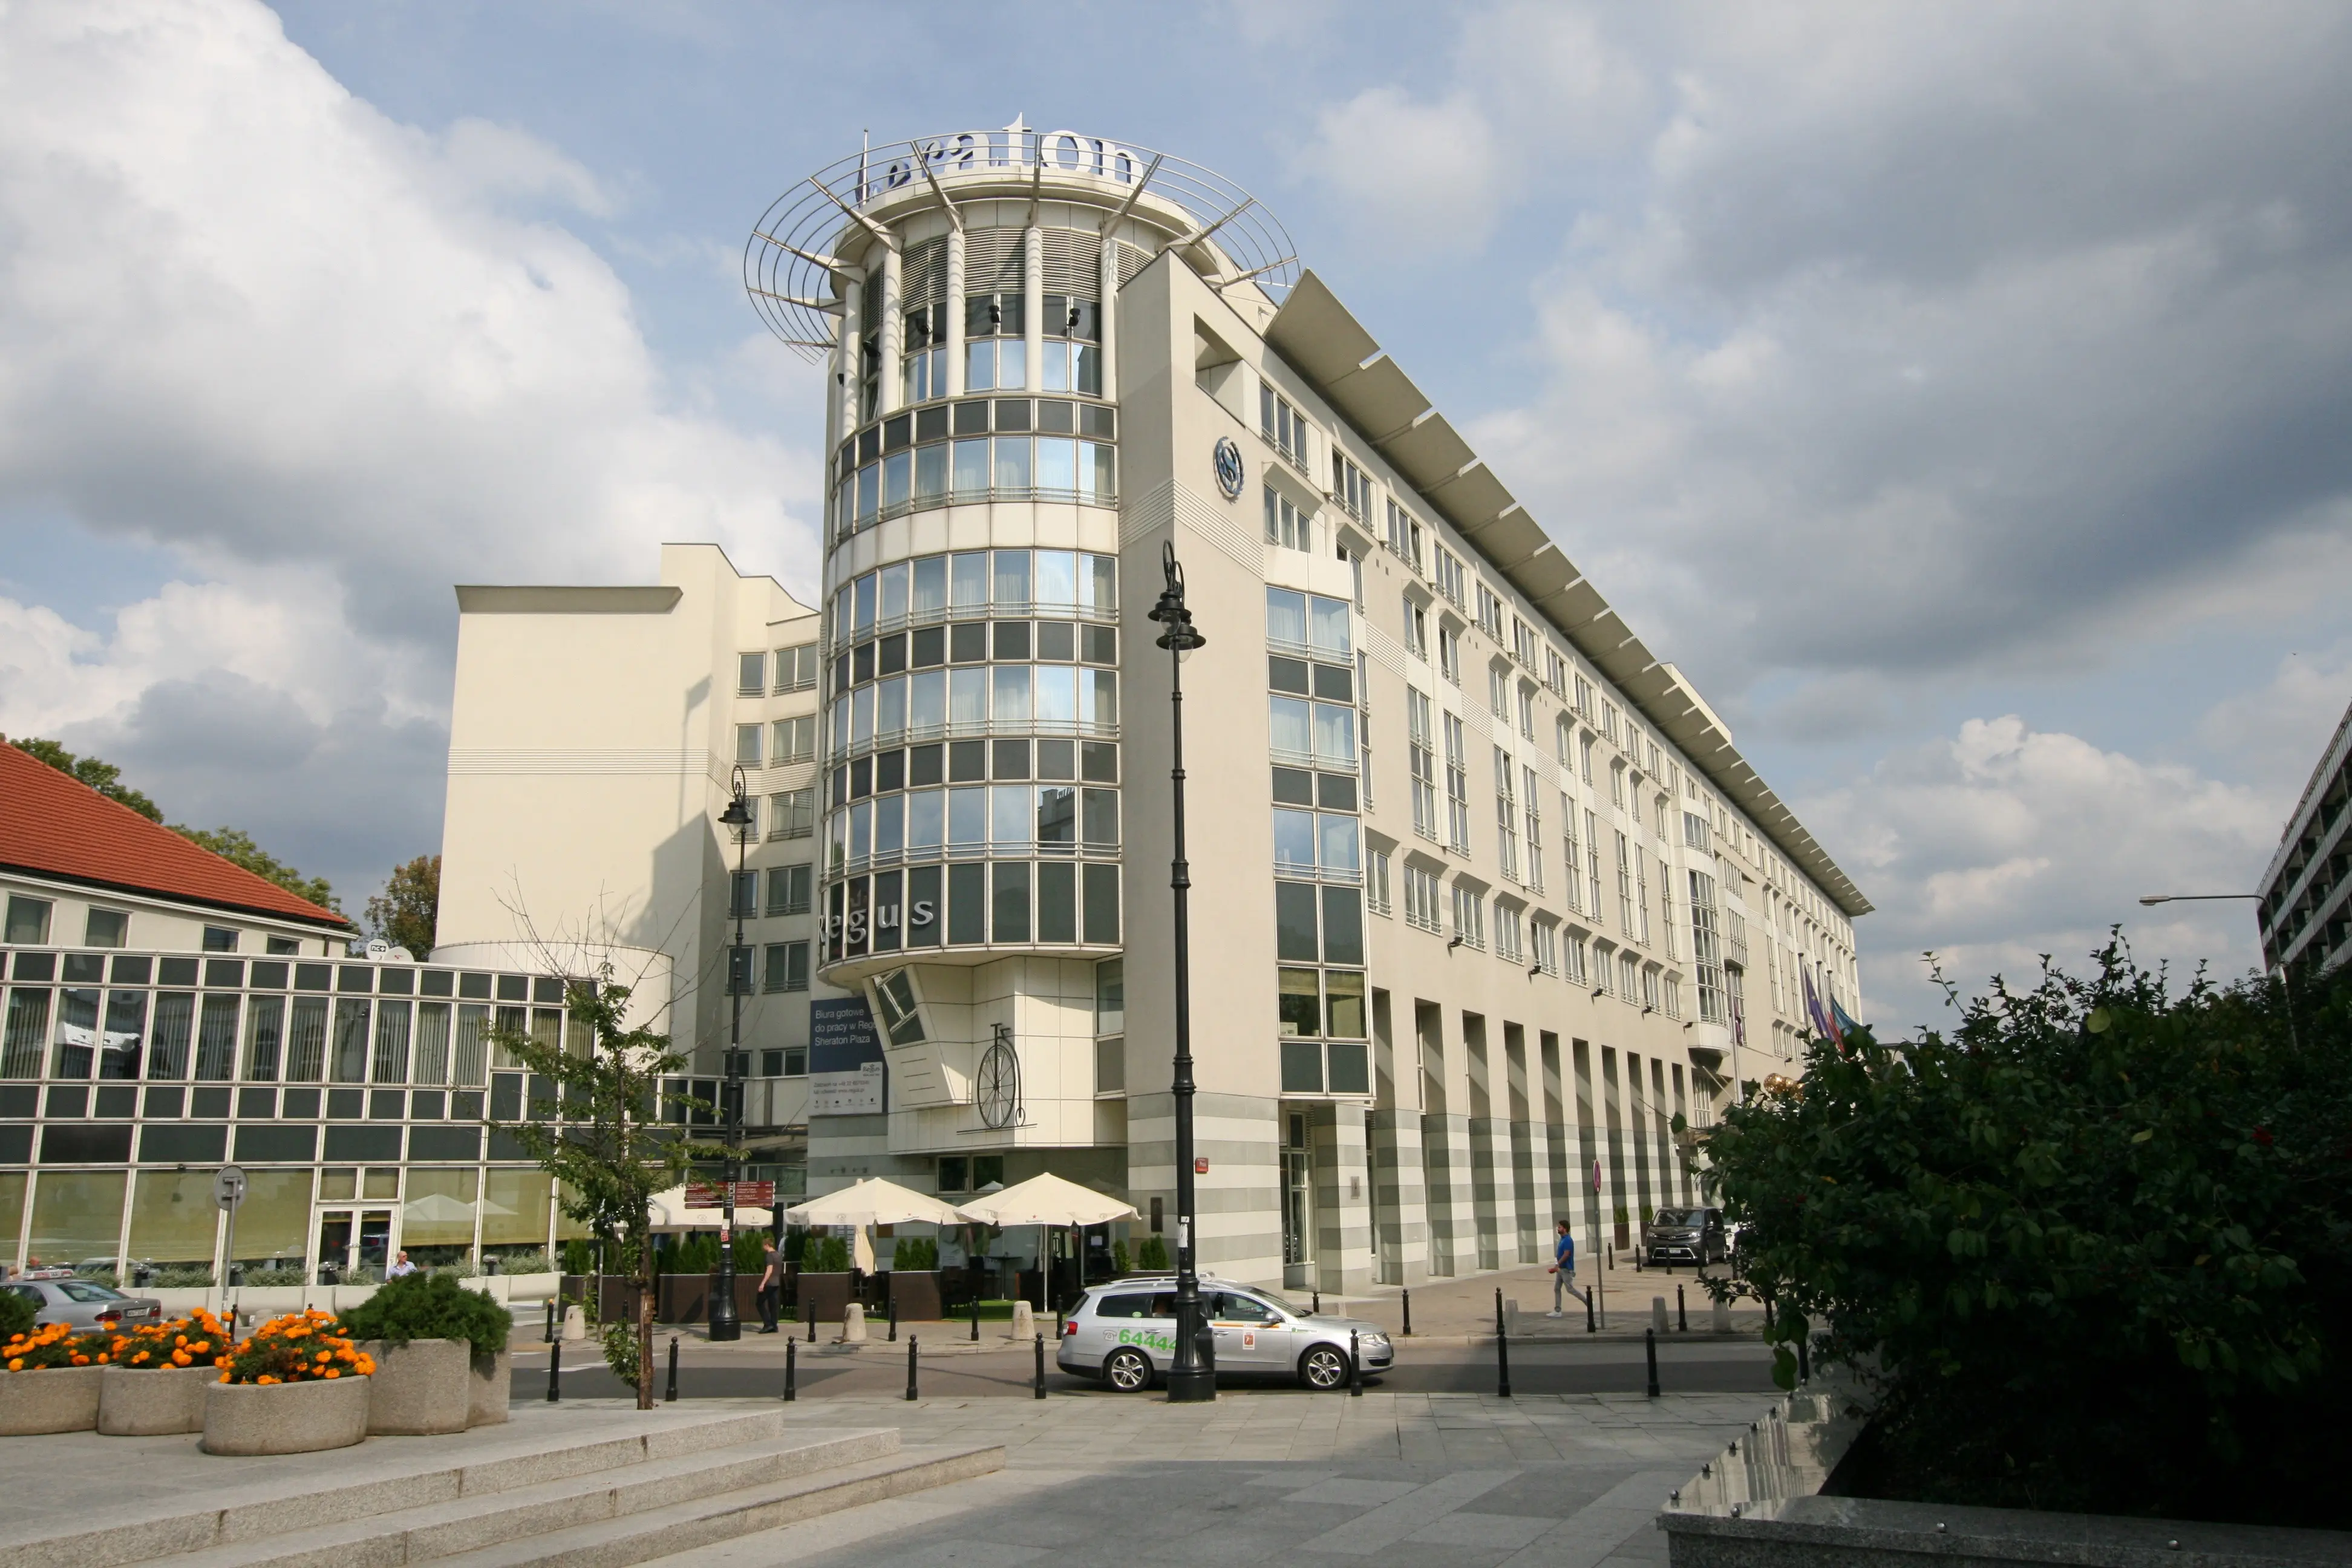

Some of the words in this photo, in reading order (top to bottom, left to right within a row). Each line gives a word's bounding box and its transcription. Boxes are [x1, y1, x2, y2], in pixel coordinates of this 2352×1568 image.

[871, 112, 1145, 192] eraton
[818, 900, 934, 945] Regus
[815, 1010, 835, 1019] Biura
[837, 1008, 864, 1019] gotowe
[815, 1024, 825, 1032] do
[827, 1024, 848, 1033] pracy
[815, 1036, 848, 1046] Sheraton
[850, 1034, 871, 1044] Plaza
